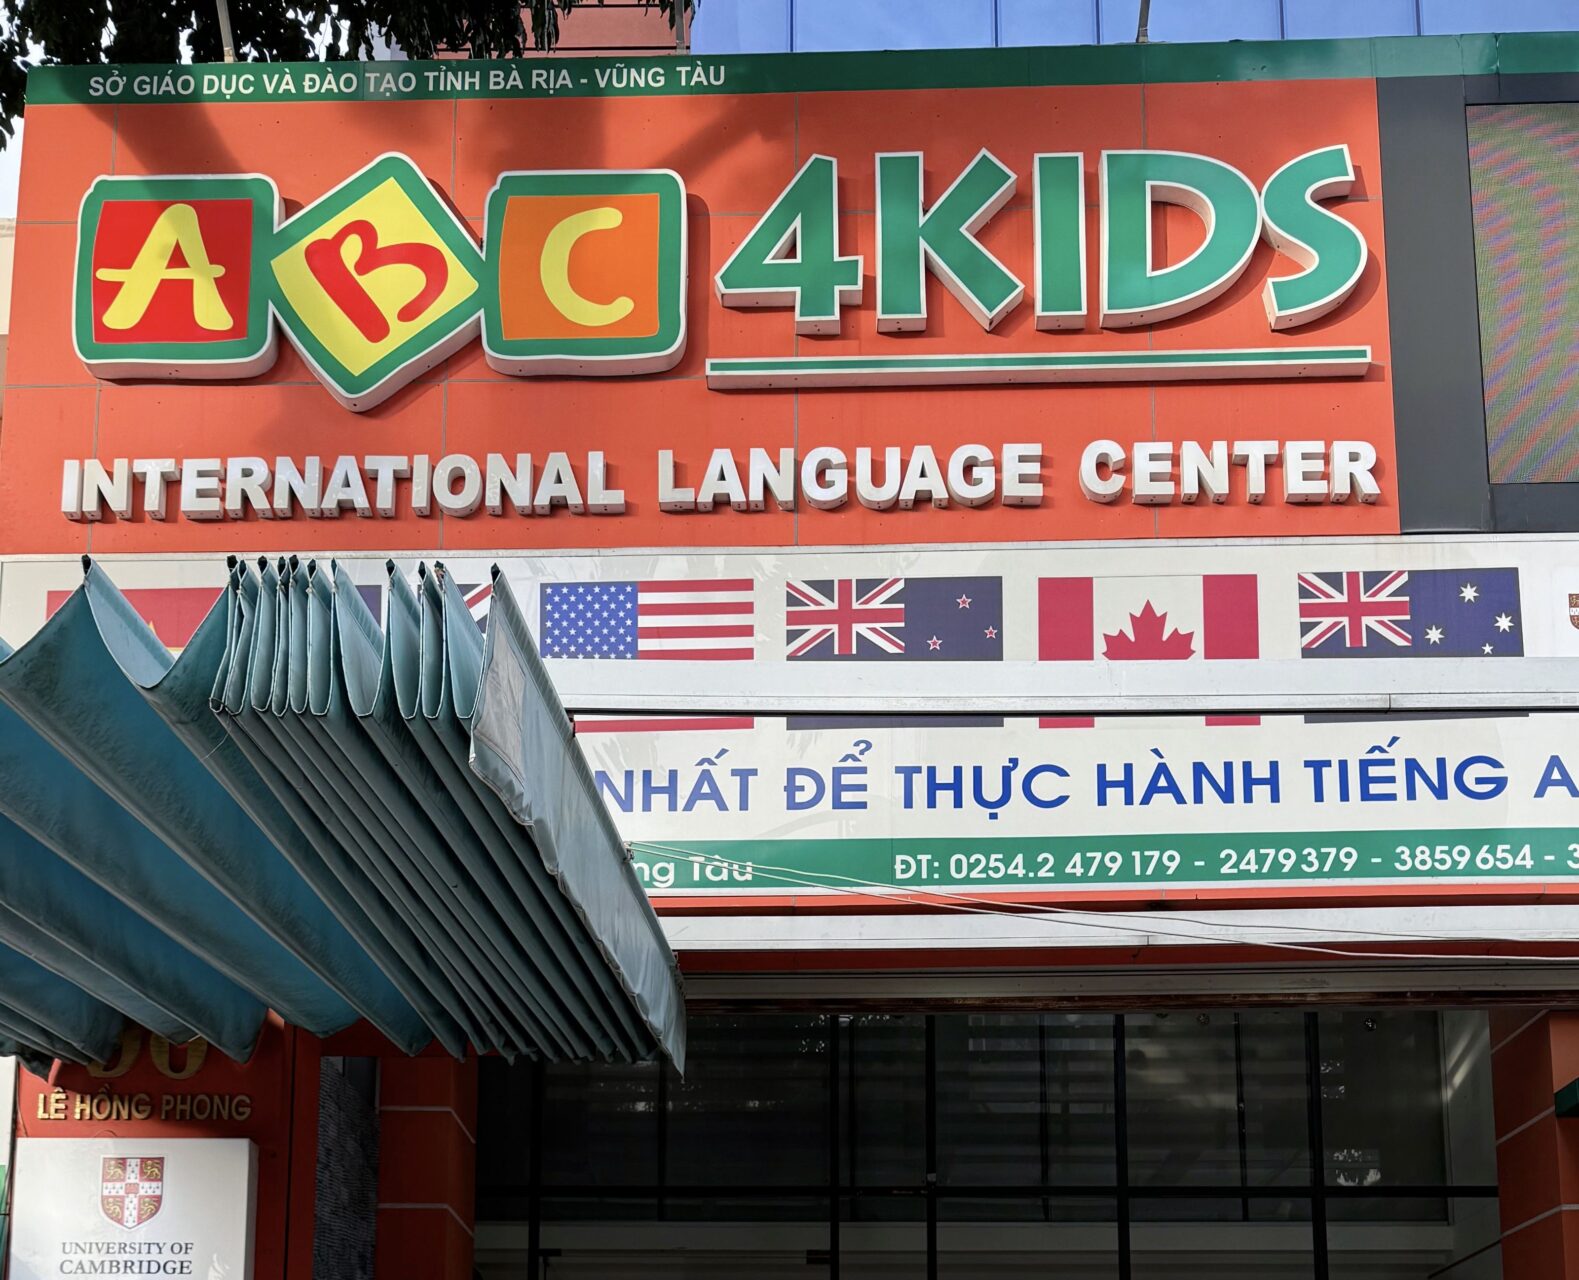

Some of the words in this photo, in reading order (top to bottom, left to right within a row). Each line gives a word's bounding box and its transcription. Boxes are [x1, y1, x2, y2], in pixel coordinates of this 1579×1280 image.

[88, 70, 127, 97] SỞ
[133, 69, 195, 95] GIÁO
[202, 73, 255, 99] DỤC
[262, 68, 296, 94] VÀ
[302, 67, 358, 94] ĐÀO
[364, 71, 417, 97] TẠO
[424, 65, 480, 92] TỈNH
[488, 64, 524, 90] BÀ
[531, 68, 573, 95] RỊA
[594, 63, 666, 89] VŨNG
[676, 61, 726, 87] TÀU
[94, 200, 636, 346] ABC
[713, 142, 1369, 335] 4KIDS
[61, 450, 627, 522] INTERNATIONAL
[656, 443, 1045, 513] LANGUAGE
[1078, 438, 1382, 506] CENTER
[594, 747, 759, 813] NHẤT
[782, 738, 874, 812] ĐỂ
[894, 757, 1071, 821] THỰC
[1096, 747, 1281, 808] HÀNH
[1303, 735, 1510, 803] TIẾNG
[1533, 754, 1579, 799] A
[688, 854, 753, 882] Tàu
[893, 854, 940, 880] ĐT:
[948, 851, 1056, 879] 0254.2
[37, 1086, 68, 1121] LÊ
[74, 1083, 153, 1121] HỒNG
[161, 1092, 253, 1122] PHONG
[59, 1258, 193, 1276] CAMBRIDGE
[61, 1241, 166, 1256] UNIVERSITY
[170, 1241, 194, 1256] OF
